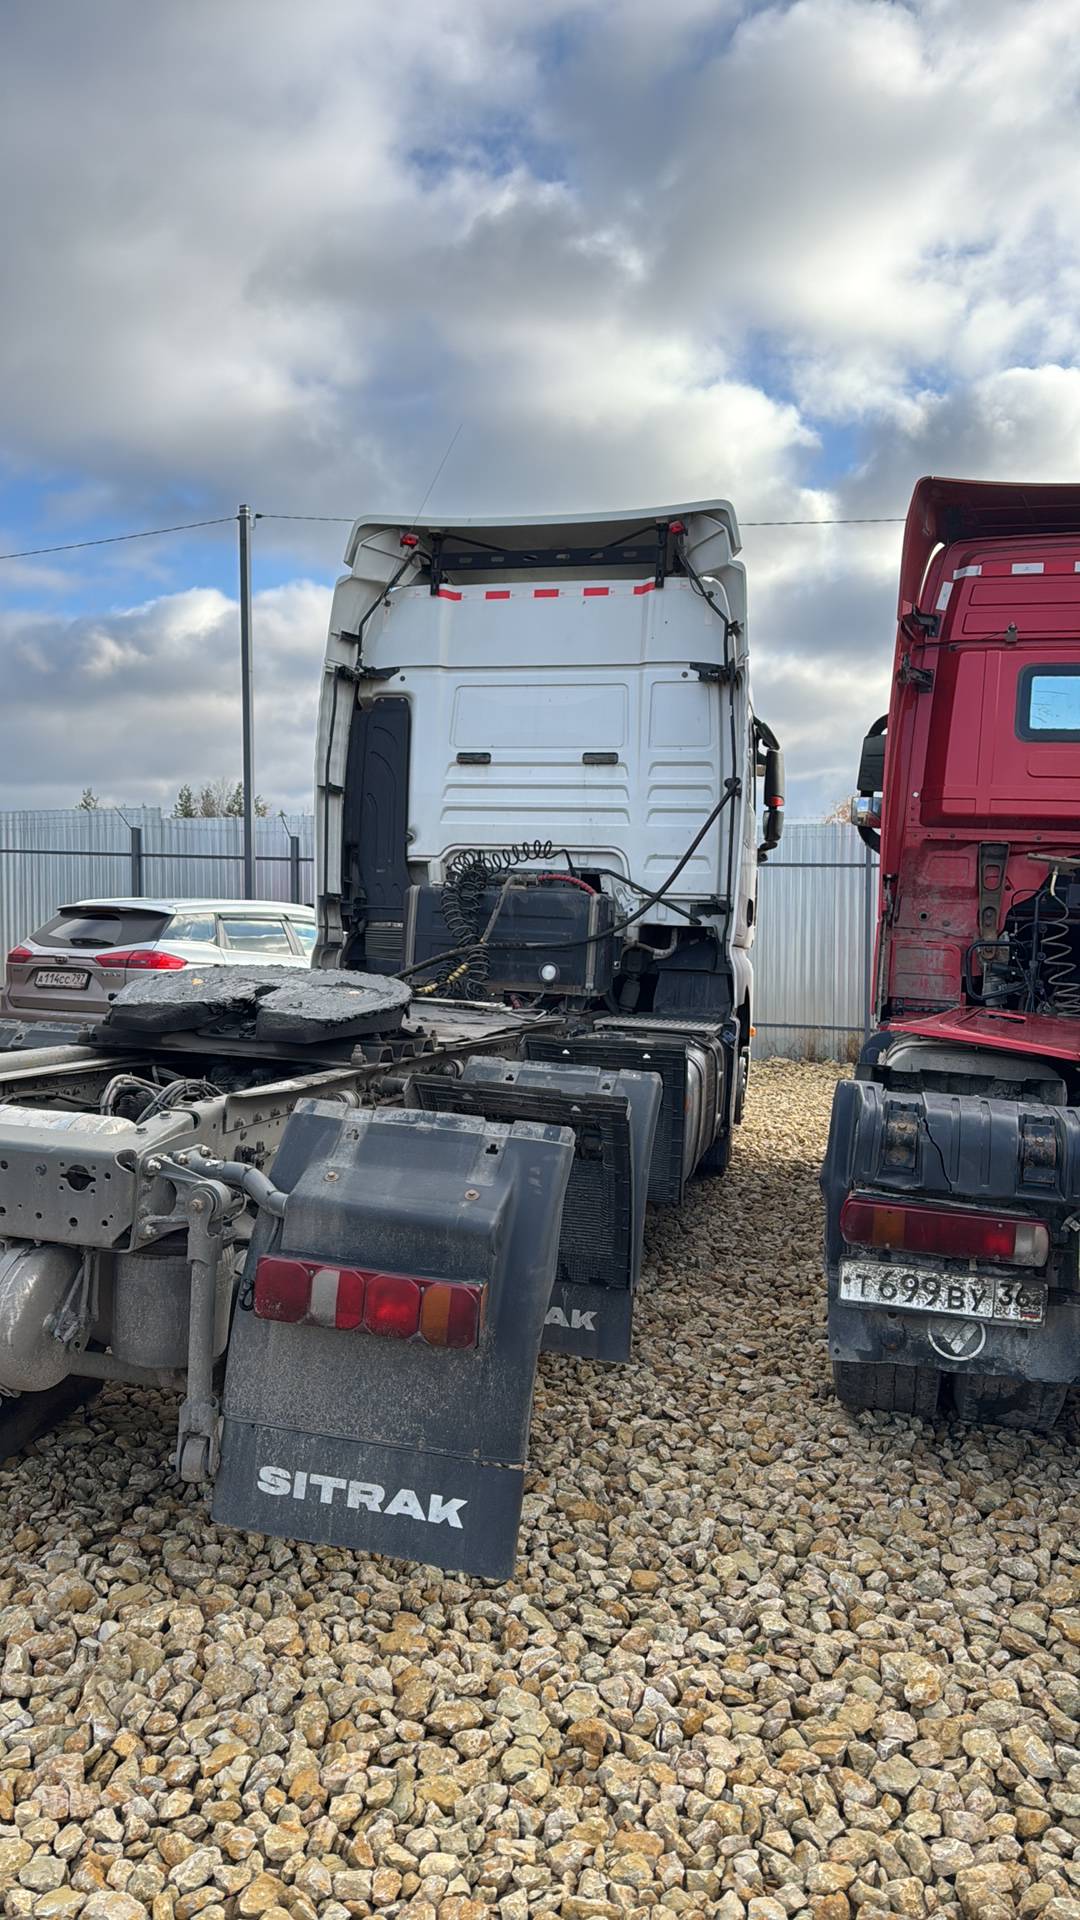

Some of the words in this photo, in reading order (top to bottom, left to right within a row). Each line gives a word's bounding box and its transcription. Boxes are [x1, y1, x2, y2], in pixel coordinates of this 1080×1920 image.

[855, 1271, 986, 1312] Т699ВУ
[999, 1281, 1031, 1307] 36
[544, 1306, 598, 1331] AK
[257, 1466, 468, 1529] SITRAK
